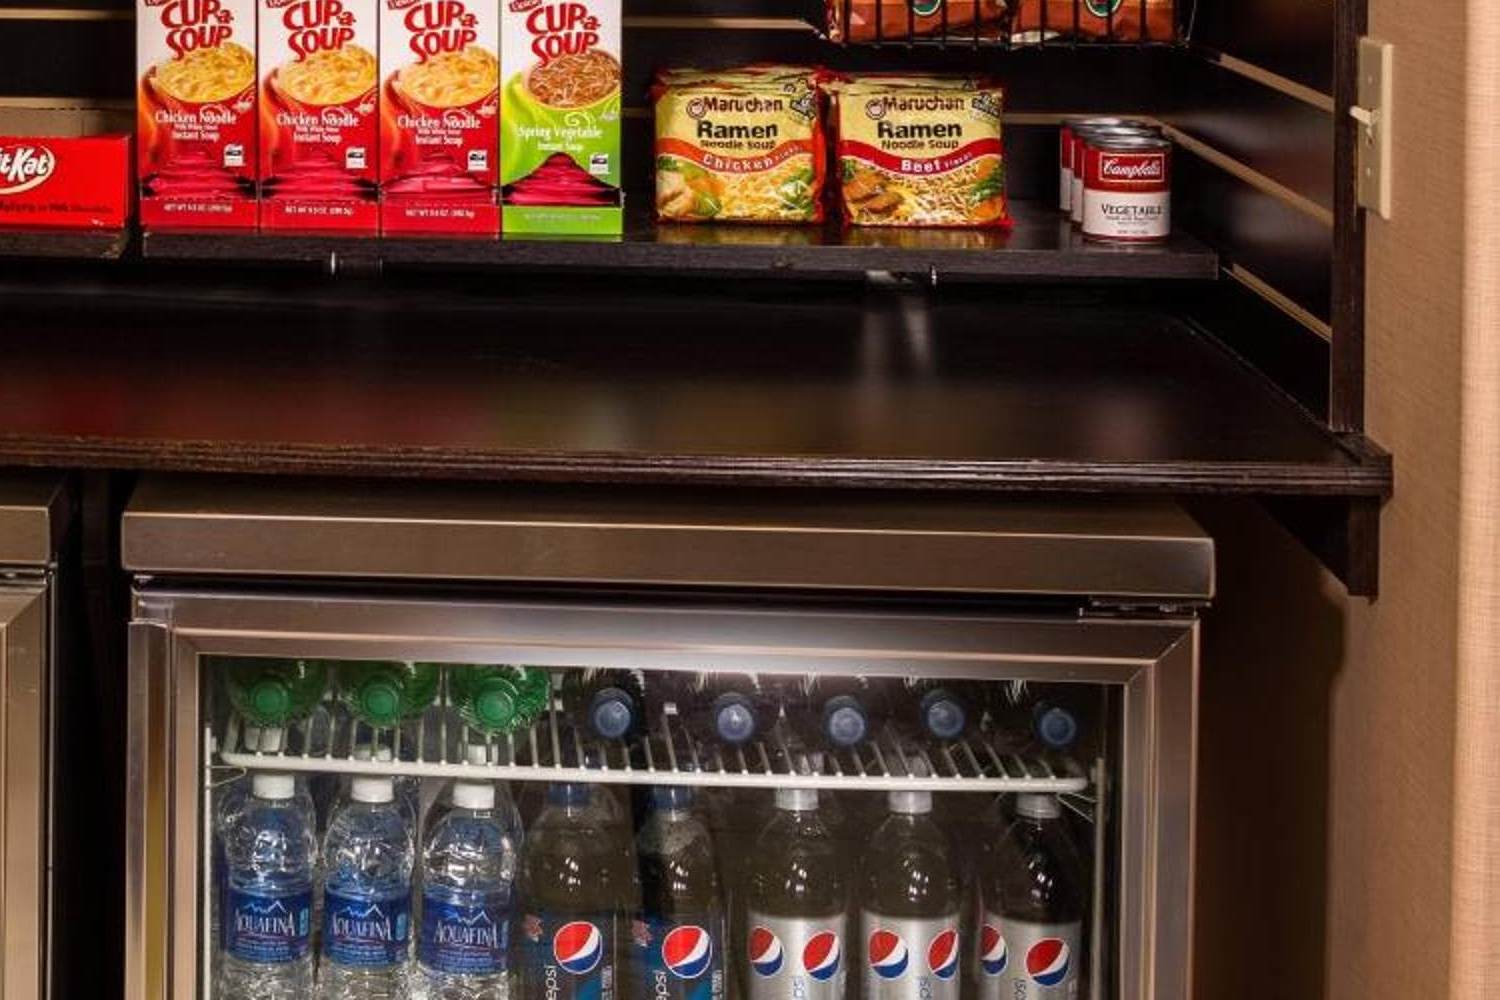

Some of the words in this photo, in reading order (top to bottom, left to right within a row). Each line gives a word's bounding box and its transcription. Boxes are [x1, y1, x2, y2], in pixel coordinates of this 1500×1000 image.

[166, 26, 233, 61] SOUP
[288, 28, 354, 63] SOUP
[409, 29, 477, 64] SOUP
[531, 32, 599, 68] SOUP
[703, 96, 783, 113] Maruchan
[883, 96, 965, 111] Maruchan
[156, 112, 196, 125] Chicken
[201, 111, 236, 125] Noodle
[276, 114, 318, 127] Chicken
[322, 113, 359, 127] Noodle
[397, 116, 439, 129] Chicken
[443, 115, 481, 129] Noodle
[200, 131, 220, 142] Soup
[517, 126, 551, 141] Spring
[555, 125, 601, 141] Vegetable
[697, 120, 778, 138] Ramen
[877, 120, 962, 138] Ramen
[322, 133, 342, 144] Soup
[444, 135, 463, 147] Soup
[700, 140, 745, 149] Noodle
[882, 140, 925, 150] Noodle
[929, 140, 958, 150] Soup
[703, 153, 773, 171] Chicken
[901, 159, 941, 172] Beef
[235, 908, 295, 936] AQUAFINA
[332, 911, 391, 941] AQUAFINA
[434, 918, 498, 948] AQUAFINA
[544, 964, 560, 1000] epsi
